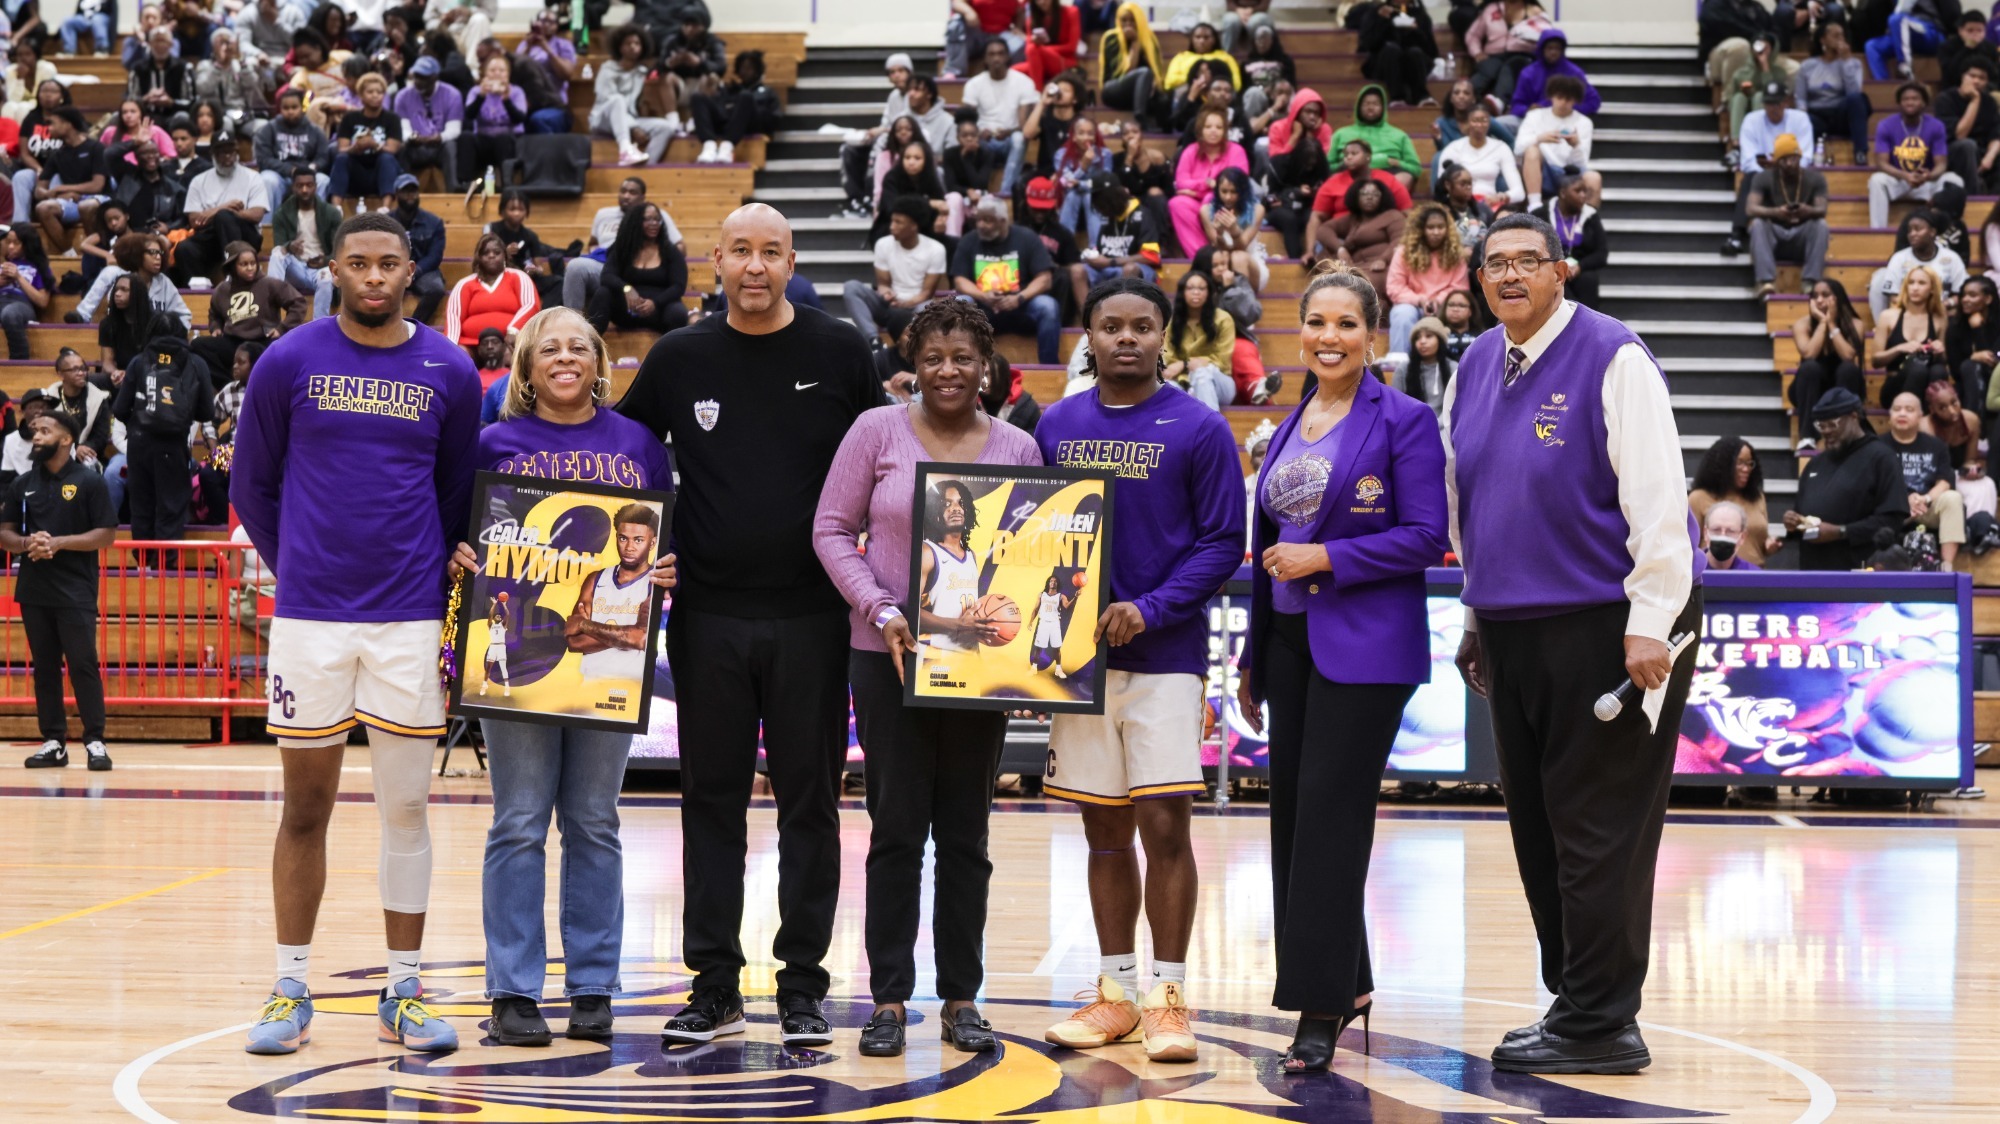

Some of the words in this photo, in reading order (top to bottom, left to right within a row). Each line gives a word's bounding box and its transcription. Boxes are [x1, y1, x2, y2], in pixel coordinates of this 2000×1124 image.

[158, 353, 171, 364] 23
[309, 375, 433, 411] BENEDICT
[318, 398, 420, 421] BASKETBALL
[1057, 440, 1164, 468] BENEDICT
[517, 487, 544, 496] BENEDICT
[488, 524, 539, 545] CALEB
[1049, 513, 1096, 532] JALEN
[992, 530, 1095, 567] BLUNT
[484, 543, 603, 585] HYMON
[1701, 614, 1820, 639] IGERS
[1697, 643, 1882, 668] KETBALL
[608, 695, 627, 703] GUARD
